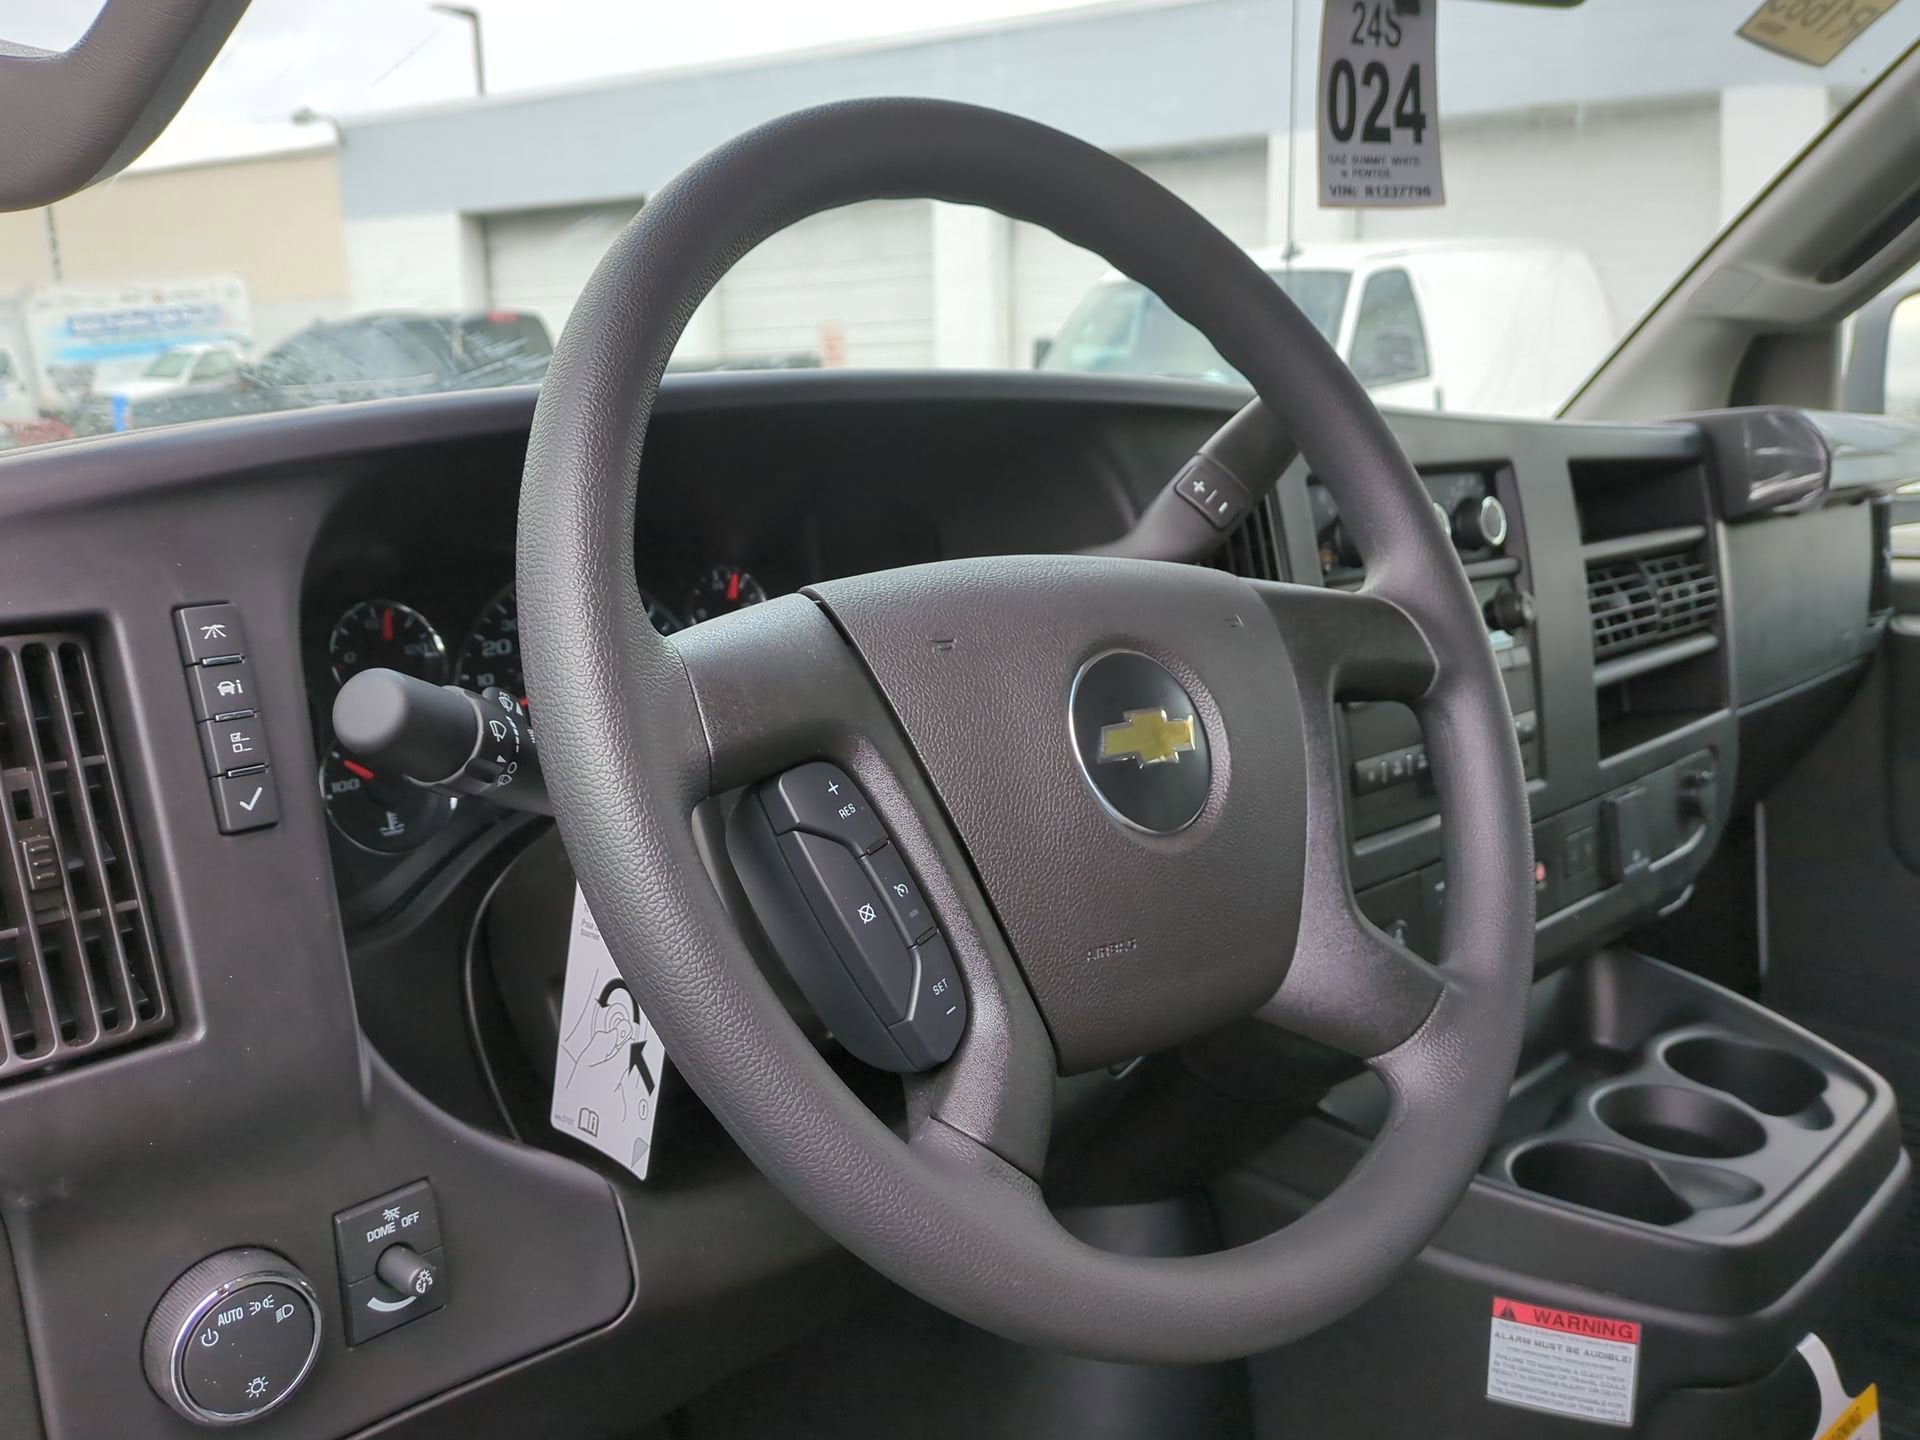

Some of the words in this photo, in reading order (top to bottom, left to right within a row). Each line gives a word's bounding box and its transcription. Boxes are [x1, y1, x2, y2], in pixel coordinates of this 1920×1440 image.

[1351, 1, 1402, 47] 24S
[1328, 58, 1426, 144] 024
[1391, 155, 1420, 166] WHITE
[1329, 184, 1356, 197] VIN:
[482, 638, 512, 657] 20
[331, 778, 360, 792] 100
[838, 803, 856, 820] RES
[933, 977, 949, 996] SET
[366, 1222, 396, 1243] DOME
[401, 1211, 420, 1228] OFF
[217, 1307, 244, 1327] AUTO
[1533, 1308, 1633, 1338] WARNING
[1494, 1332, 1531, 1344] ALARM
[1533, 1339, 1563, 1352] MUST
[1565, 1346, 1581, 1355] BE
